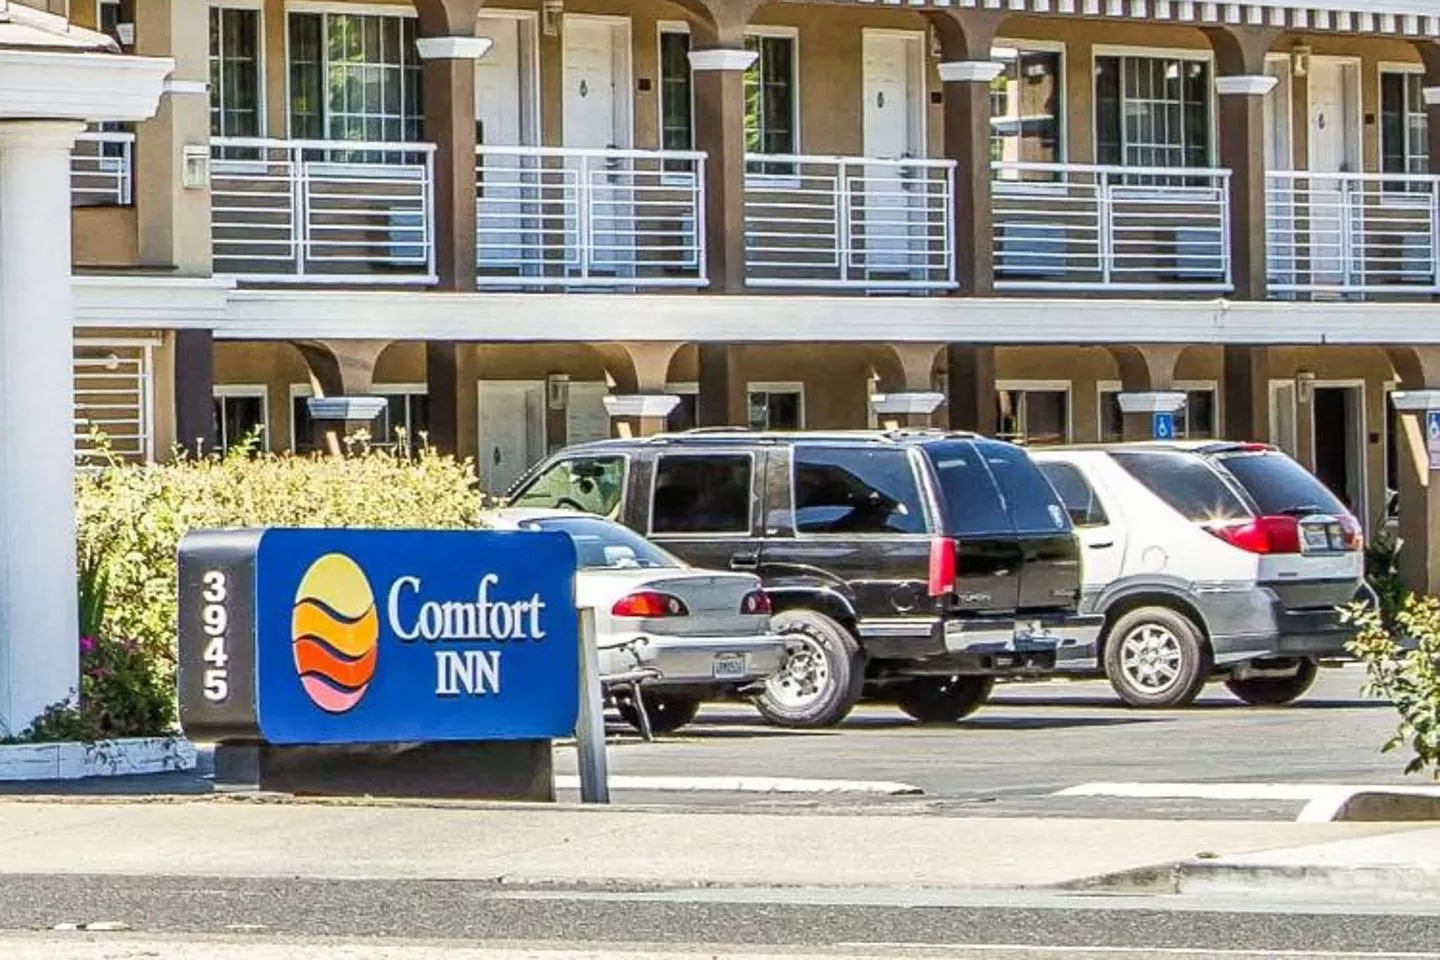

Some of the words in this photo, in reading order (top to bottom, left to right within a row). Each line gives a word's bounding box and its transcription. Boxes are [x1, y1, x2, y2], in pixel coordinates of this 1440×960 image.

[201, 570, 228, 700] 3945
[388, 573, 546, 641] Comfort
[434, 651, 501, 695] INN
